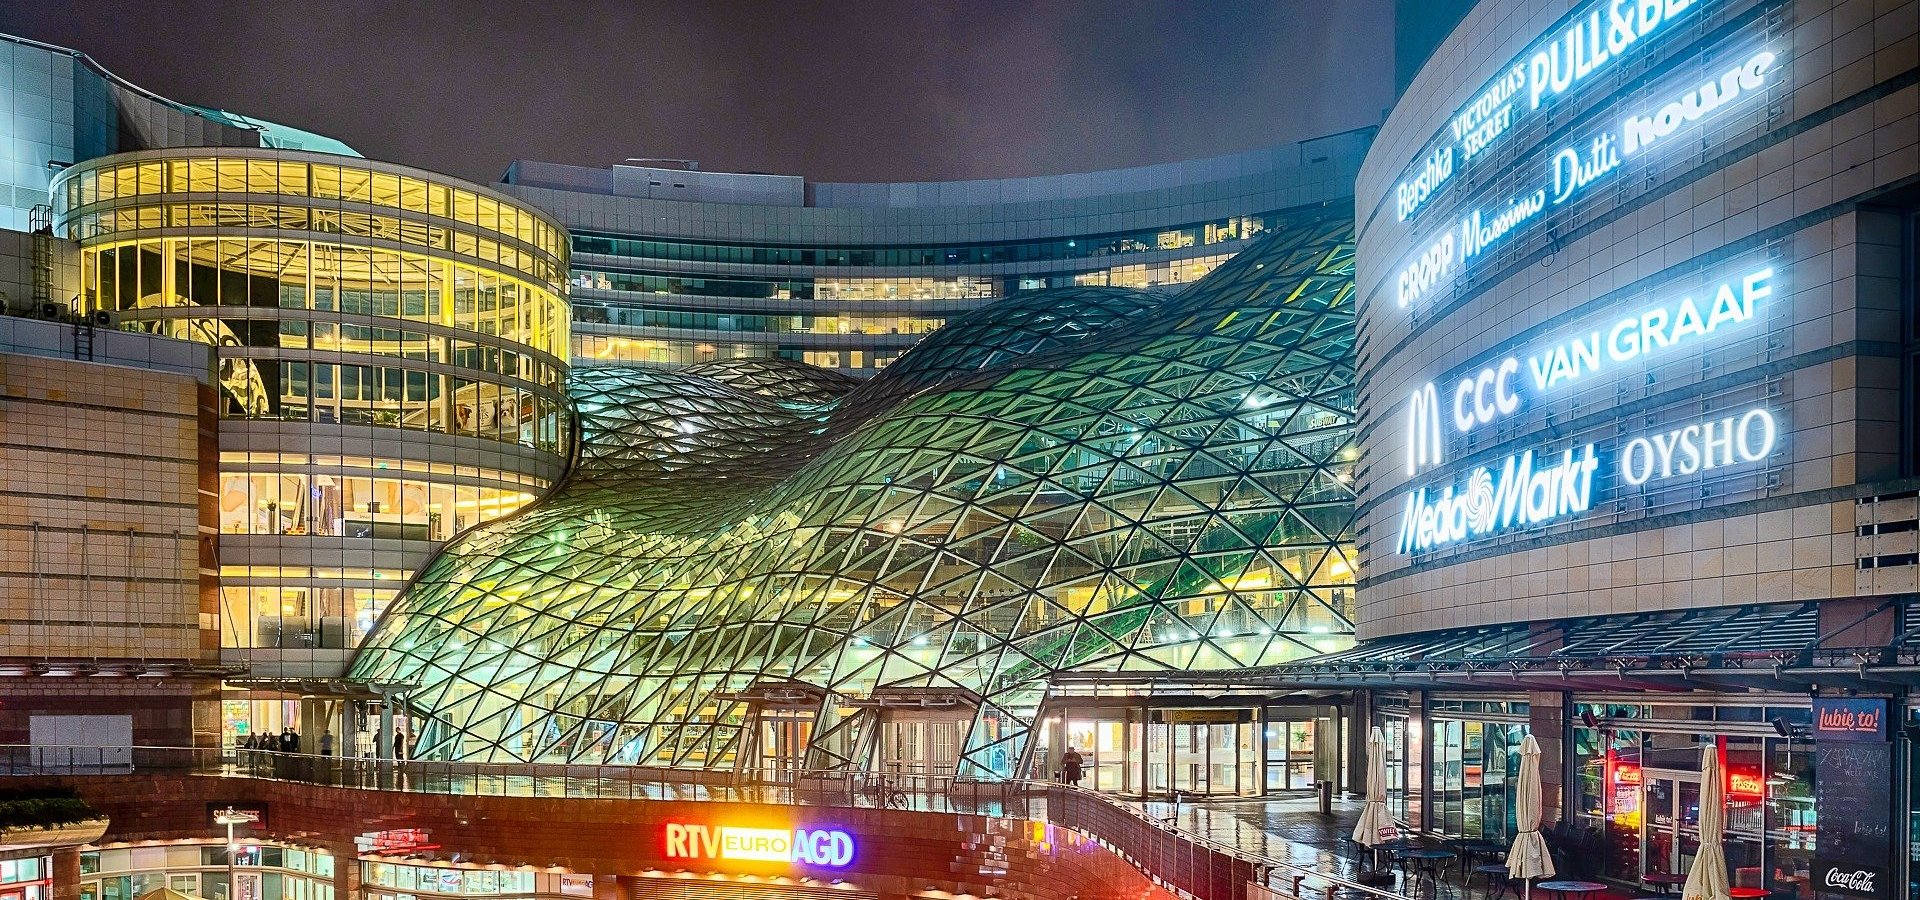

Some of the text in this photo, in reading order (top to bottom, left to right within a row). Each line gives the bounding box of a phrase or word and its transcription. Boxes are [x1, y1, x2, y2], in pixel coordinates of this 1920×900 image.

[1452, 62, 1525, 141] VICTORIA'S
[1464, 104, 1513, 161] SECRET
[1624, 51, 1775, 155] house
[1399, 147, 1453, 222] Bershka
[1460, 136, 1621, 263] Massimo Dutti
[1398, 231, 1454, 308] CROPP
[1528, 268, 1774, 391] VAN GRAAF
[1454, 357, 1520, 432] CCC
[1622, 408, 1777, 485] OYSHO
[666, 823, 854, 866] RTV EURO AGD
[1825, 867, 1875, 892] Coca-Cola
